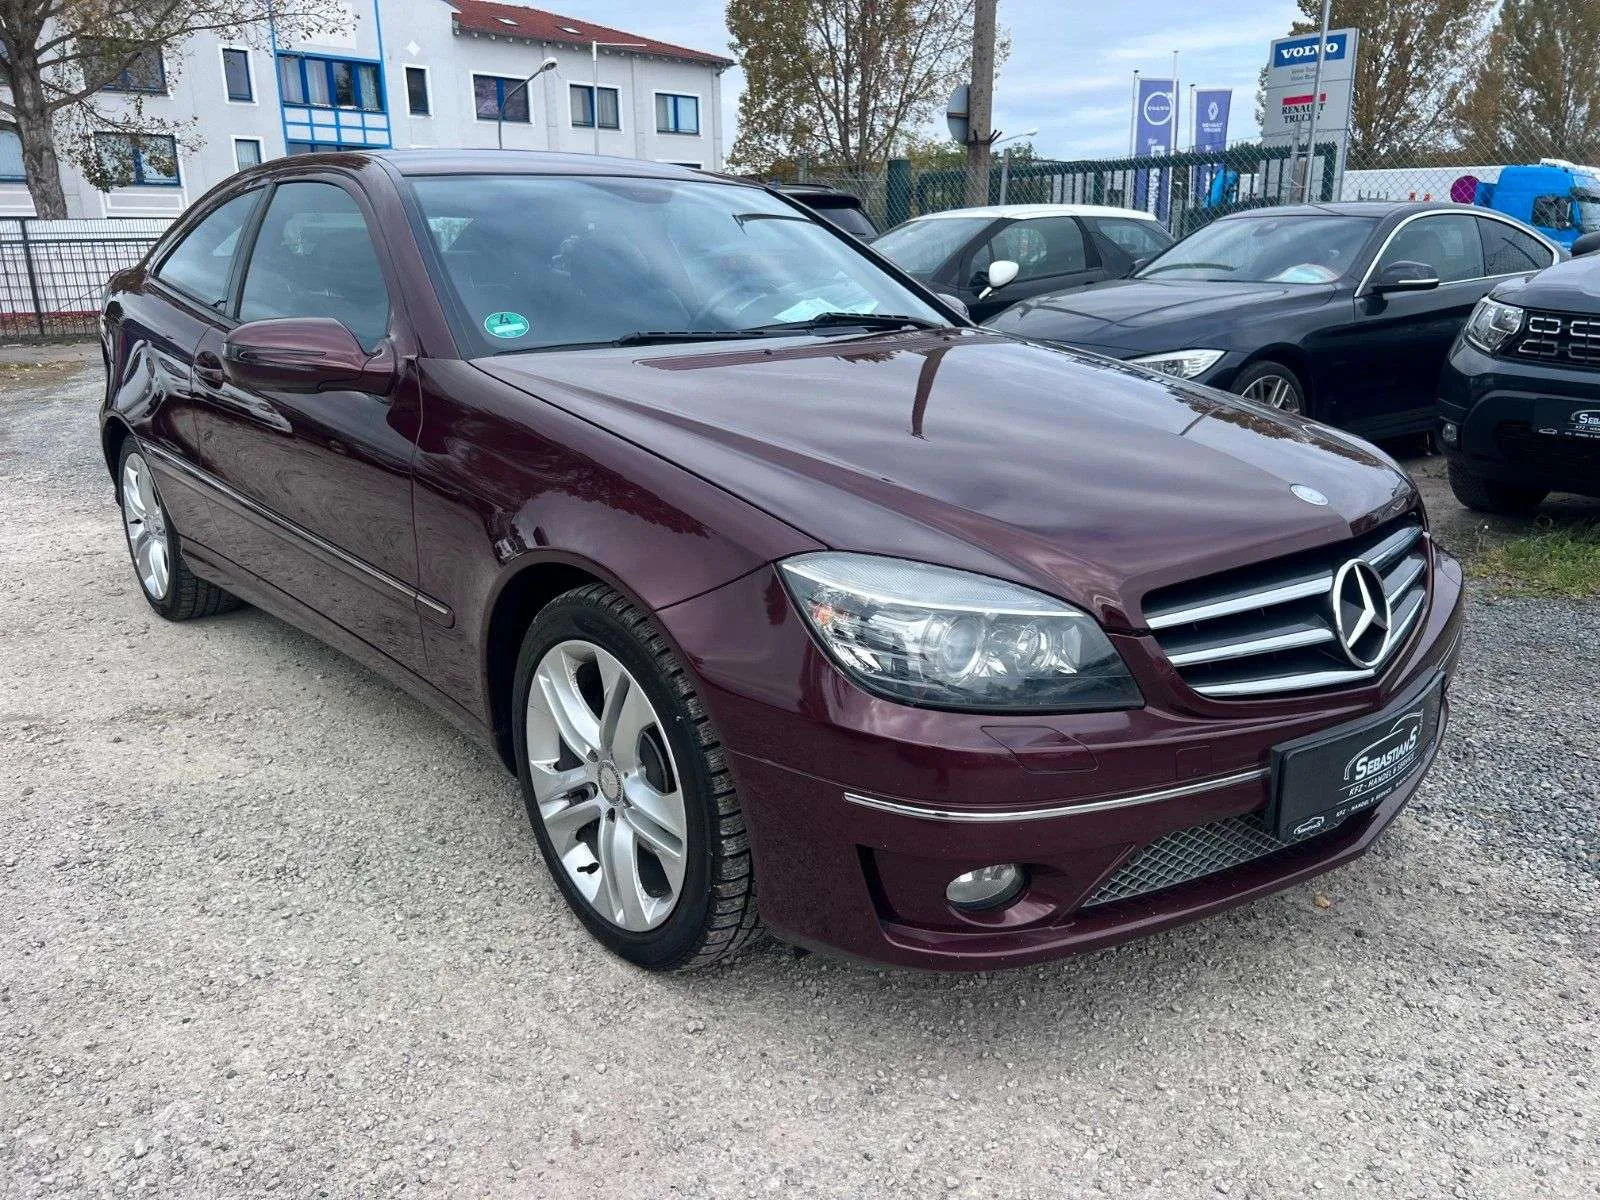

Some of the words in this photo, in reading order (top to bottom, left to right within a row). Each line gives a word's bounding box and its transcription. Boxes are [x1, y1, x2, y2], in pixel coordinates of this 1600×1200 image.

[1280, 42, 1339, 59] VOLVO
[1281, 102, 1326, 115] RENAUT
[1579, 413, 1600, 424] SEB
[1348, 783, 1364, 796] KFZ
